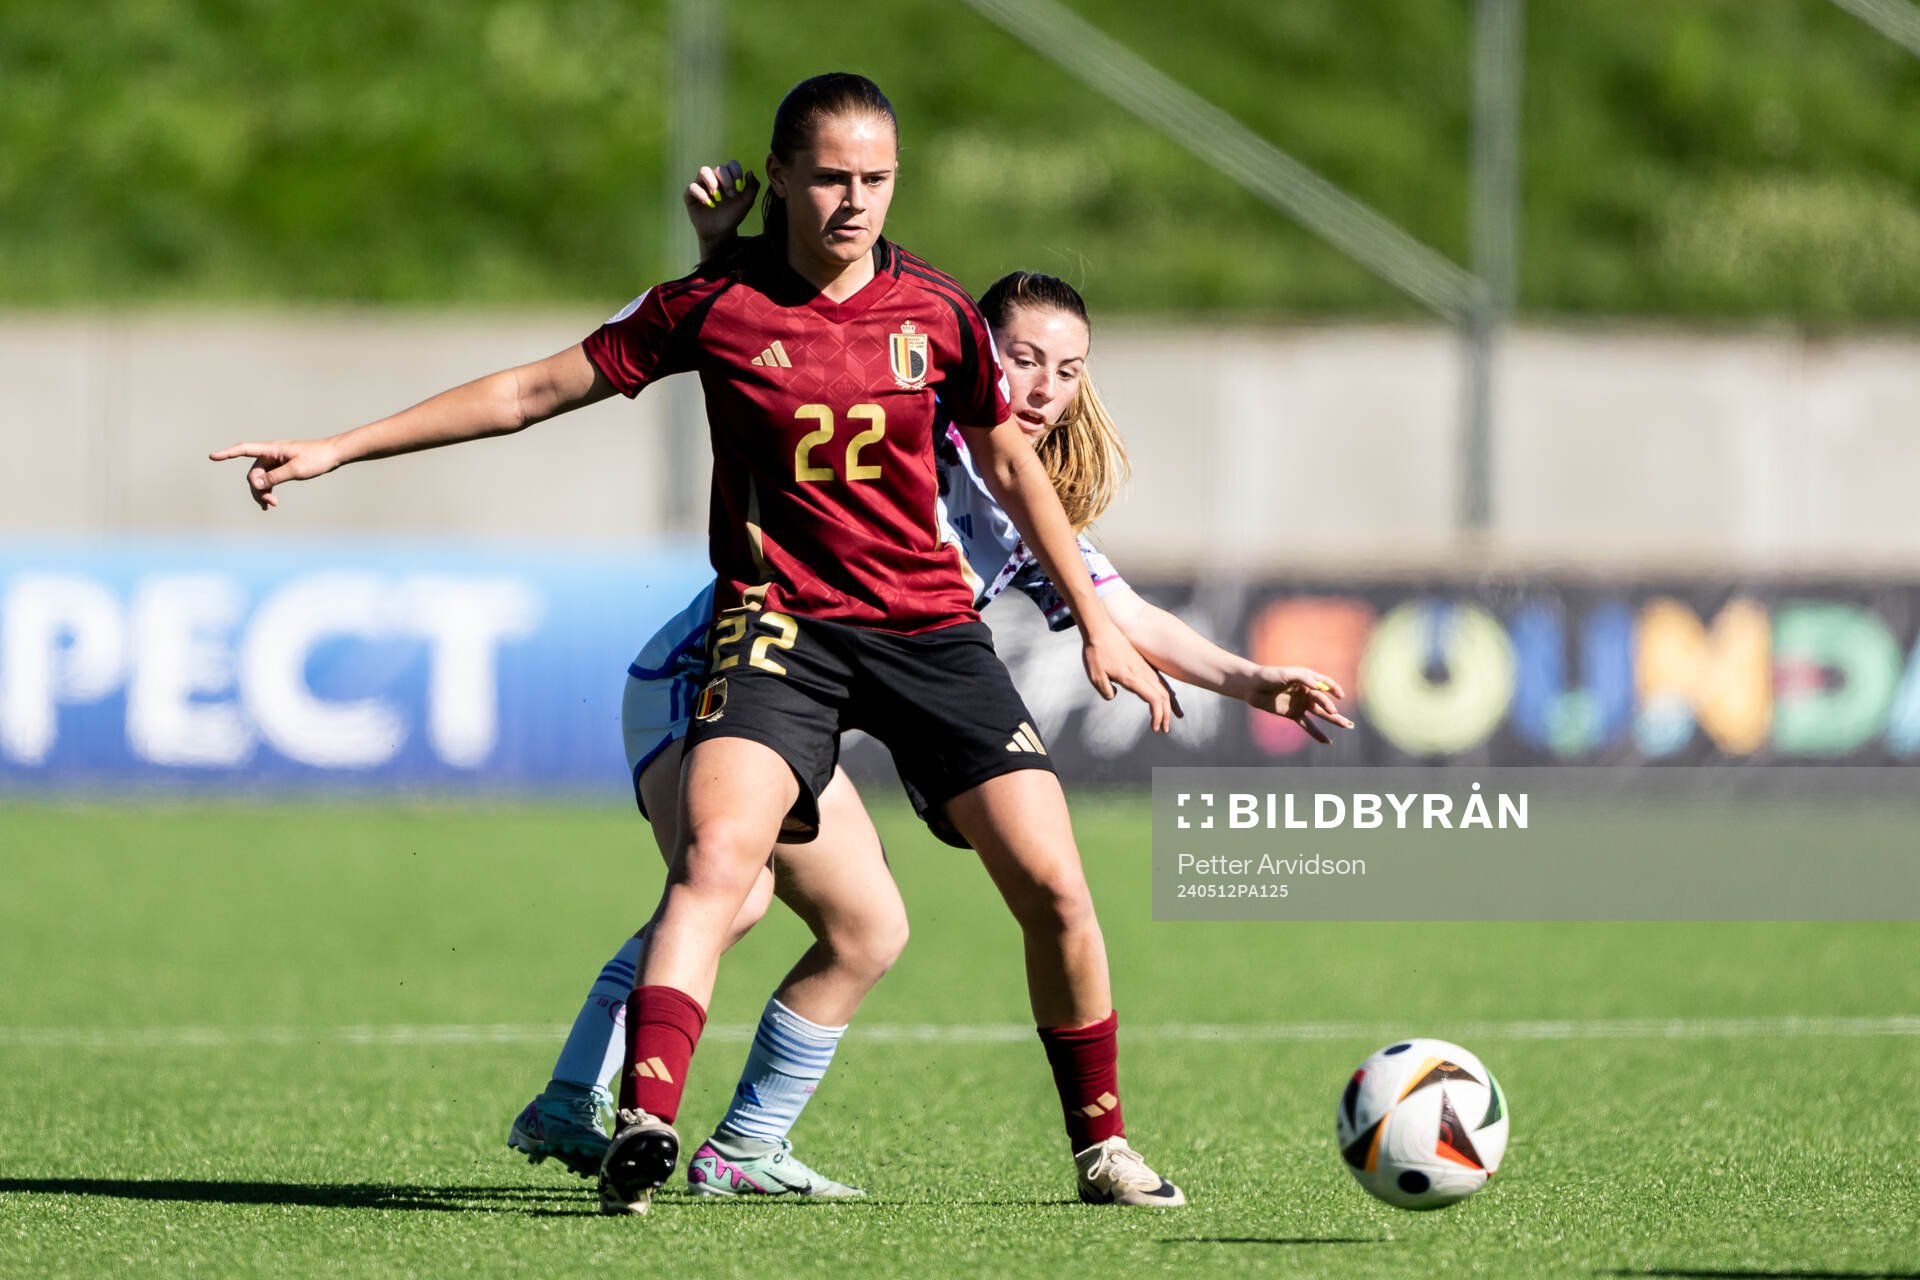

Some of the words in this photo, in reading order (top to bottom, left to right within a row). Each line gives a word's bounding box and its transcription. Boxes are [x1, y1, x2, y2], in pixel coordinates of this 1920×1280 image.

[794, 403, 886, 482] 22
[1, 571, 541, 767] PECT
[710, 611, 799, 676] 22
[1248, 598, 1919, 758] FOUND
